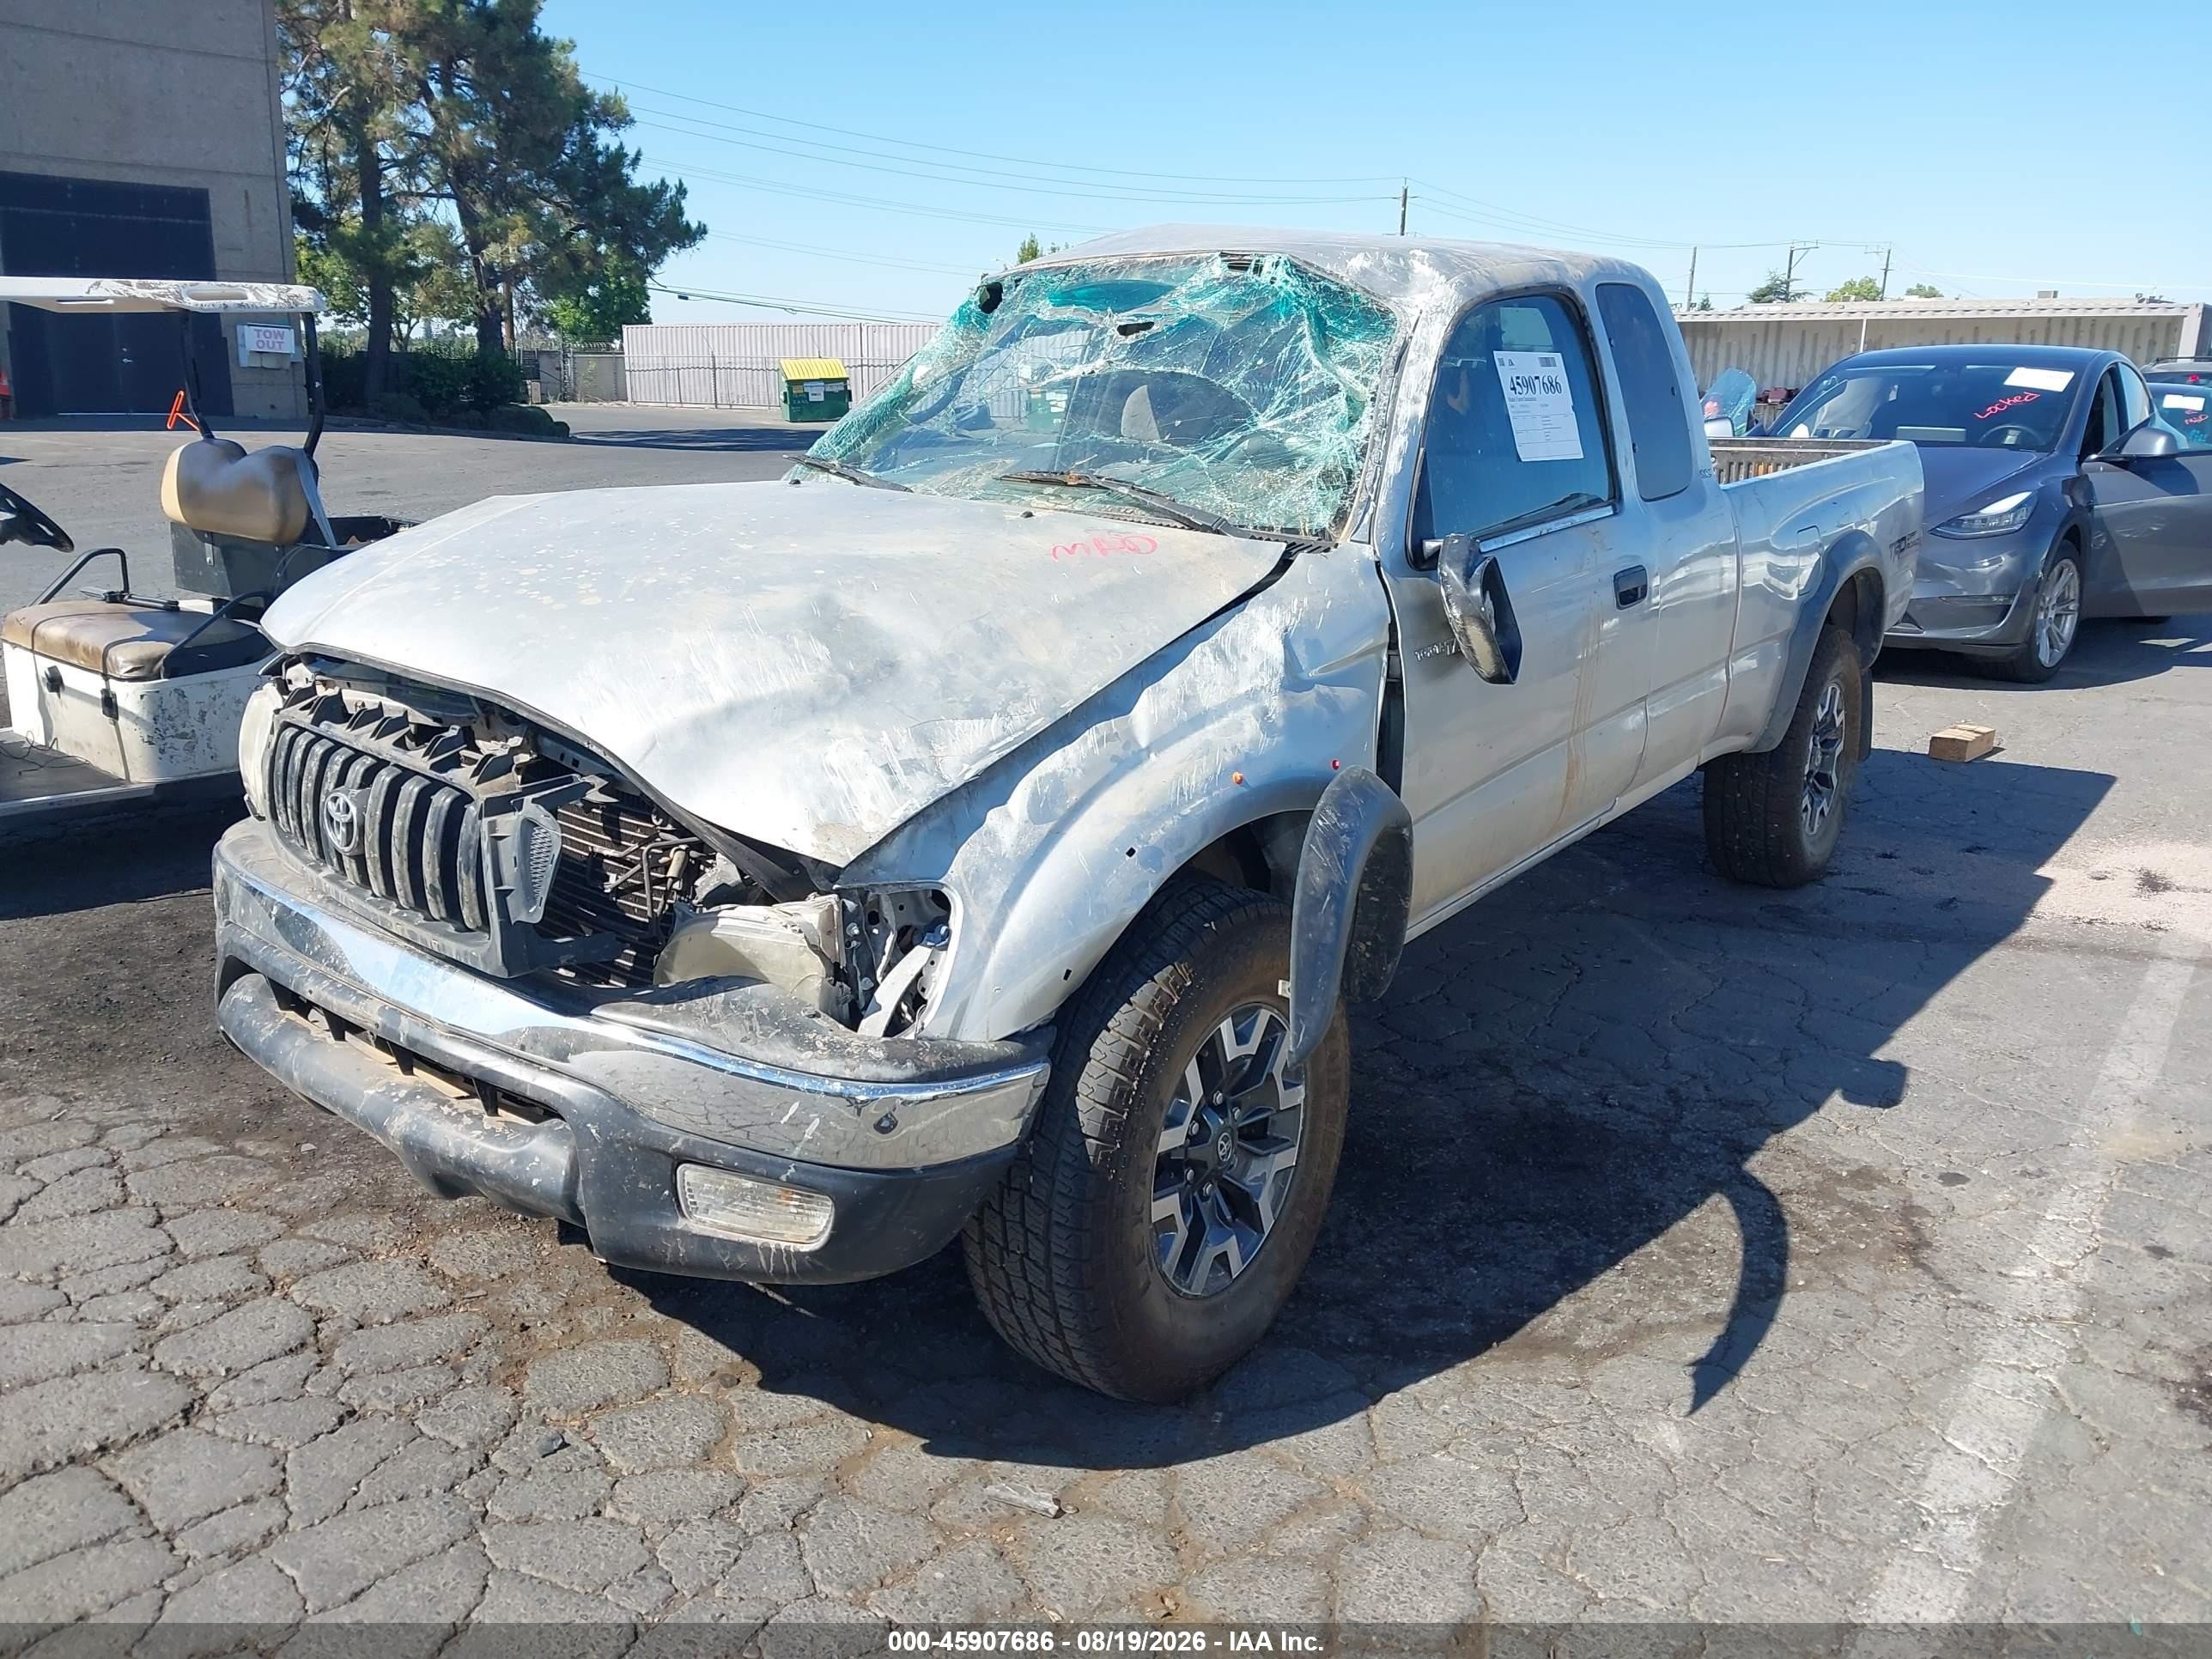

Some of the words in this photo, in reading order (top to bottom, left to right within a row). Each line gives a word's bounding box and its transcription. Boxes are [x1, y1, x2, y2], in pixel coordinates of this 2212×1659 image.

[254, 329, 284, 339] TOW
[256, 340, 283, 349] OUT
[1510, 375, 1562, 395] 45907686
